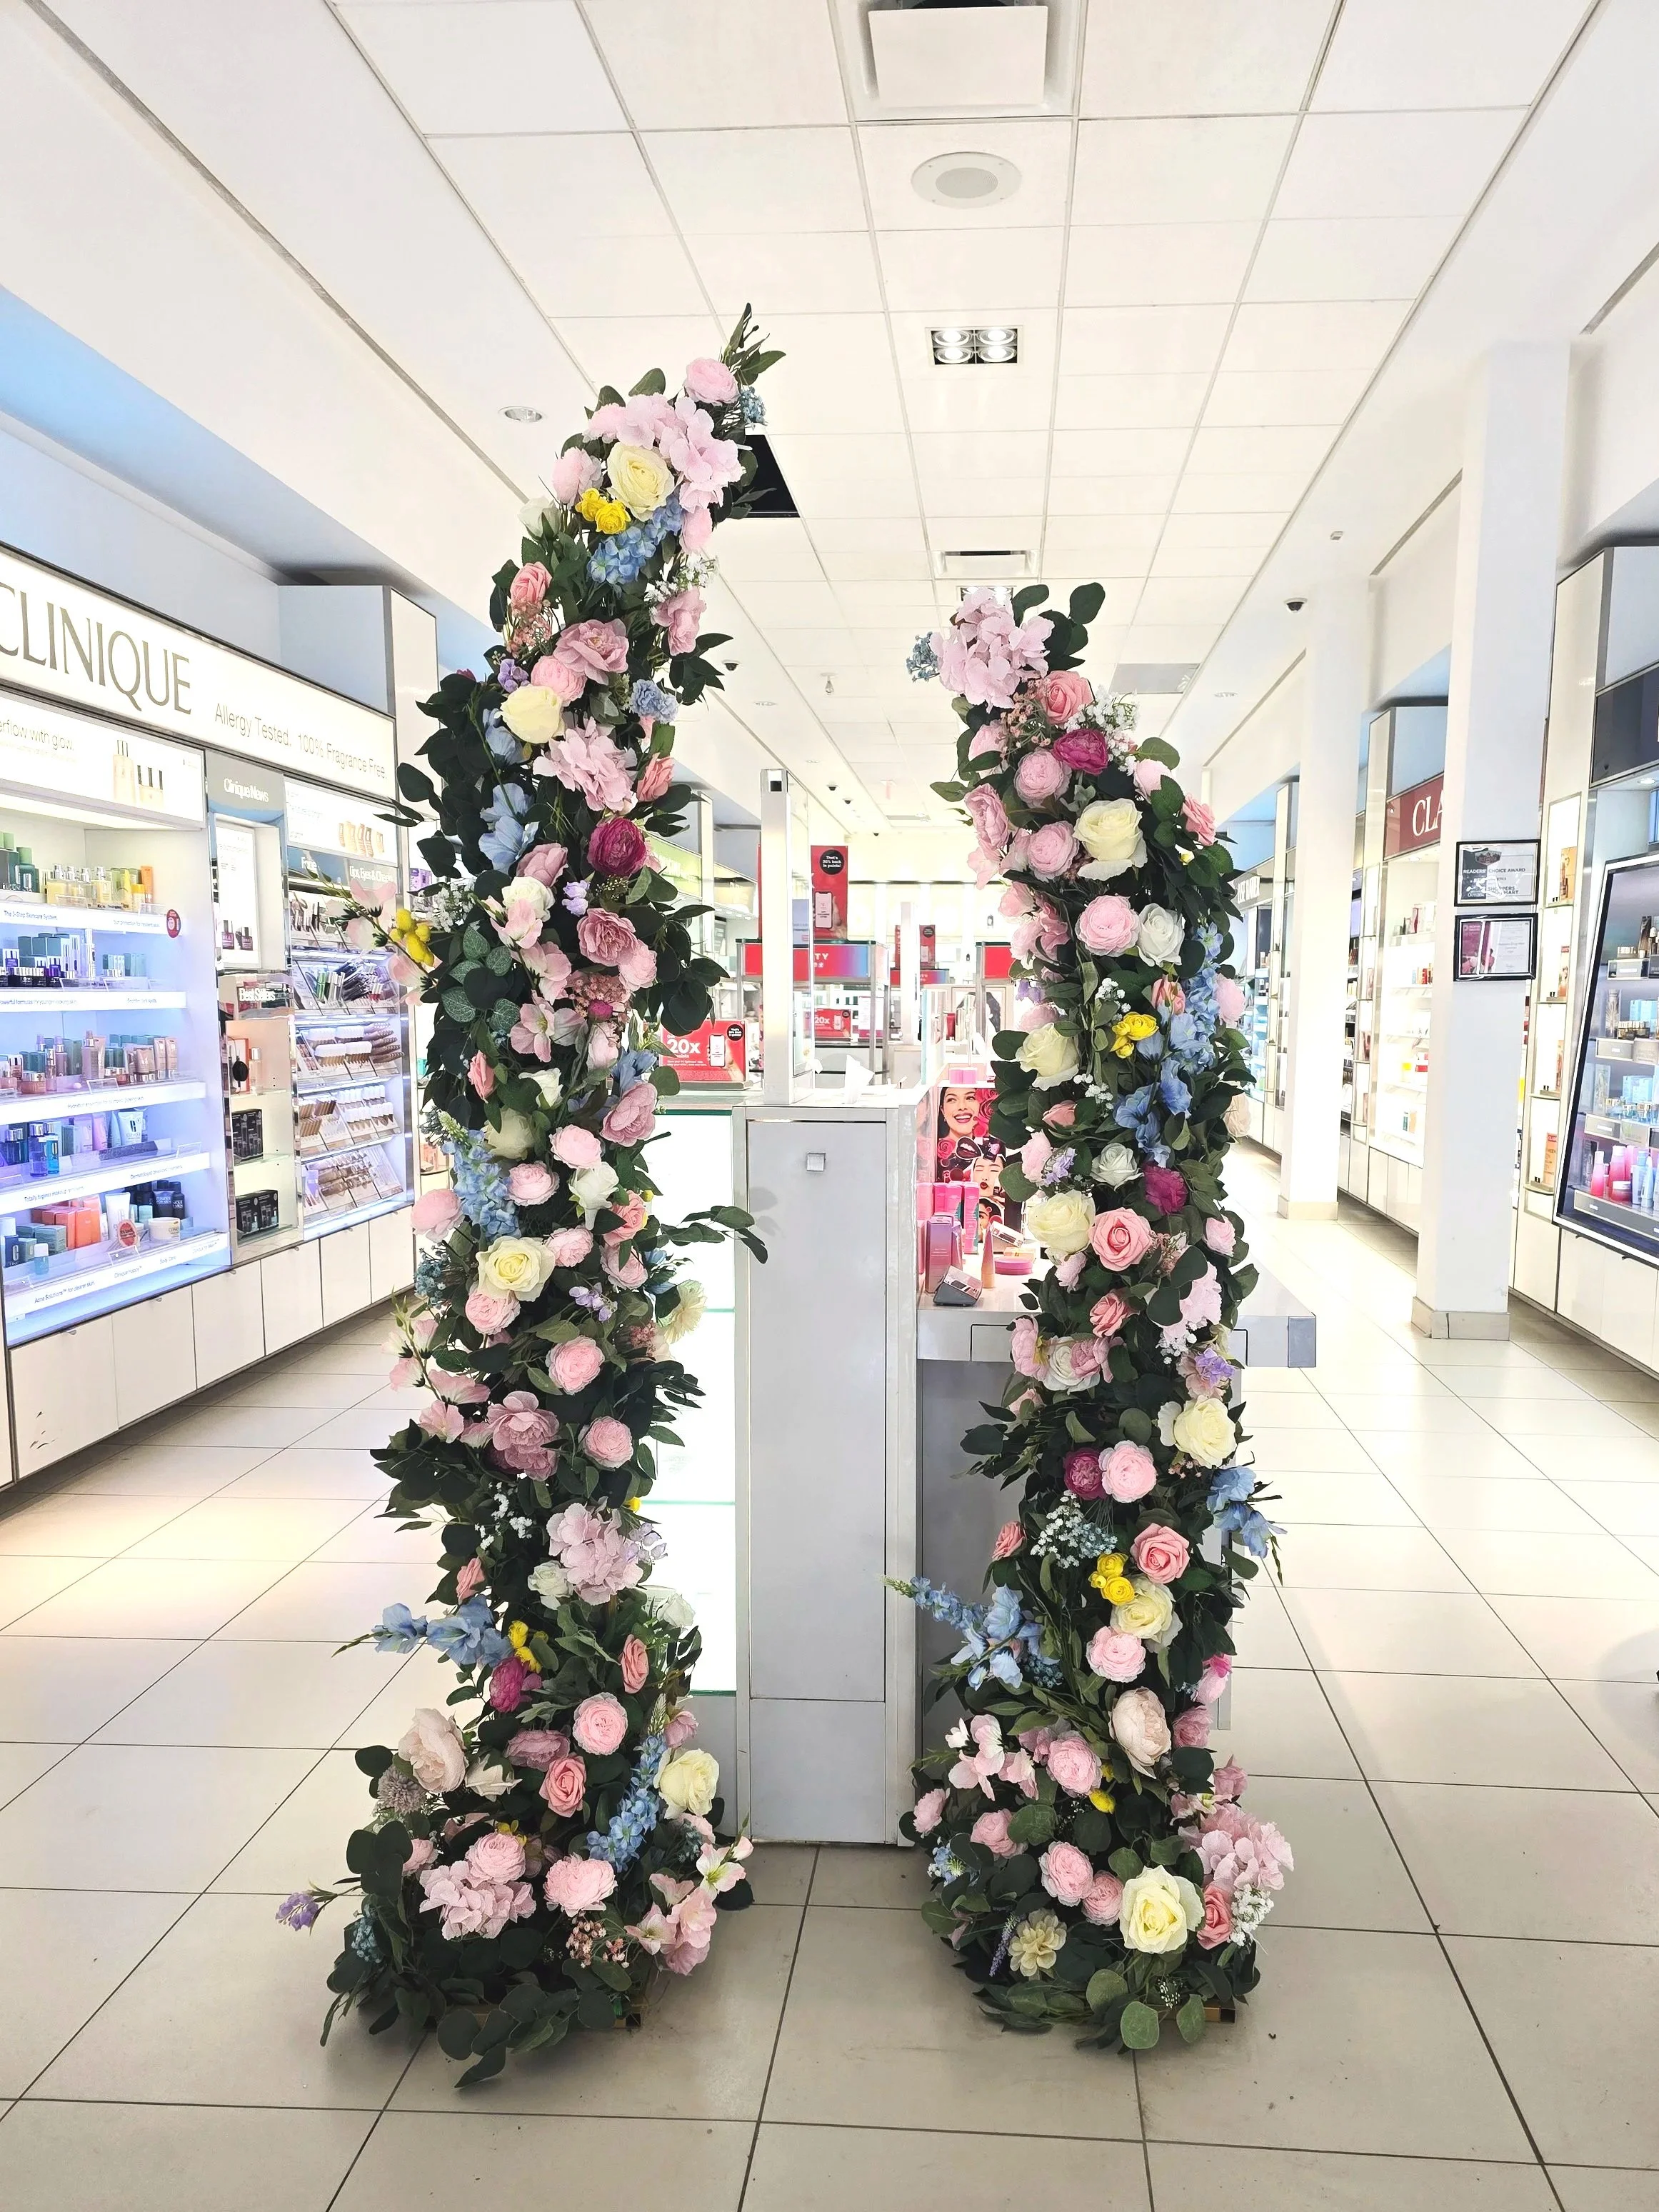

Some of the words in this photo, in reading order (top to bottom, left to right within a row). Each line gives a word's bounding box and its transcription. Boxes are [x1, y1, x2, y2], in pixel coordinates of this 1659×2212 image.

[0, 581, 191, 714] CLINIQUE
[29, 726, 50, 744] with
[52, 731, 74, 751] glow.
[215, 703, 251, 737] Allergy
[255, 716, 291, 746] Tested.
[297, 732, 324, 758] 100%
[326, 743, 367, 769] Fragrance
[369, 759, 388, 779] Free.
[224, 778, 251, 799] Clinique
[250, 784, 269, 802] News
[239, 987, 254, 1001] Best
[667, 1039, 701, 1054] 20x
[114, 1270, 129, 1279] Clinique
[34, 1295, 45, 1304] Acne
[73, 1284, 86, 1293] clearer
